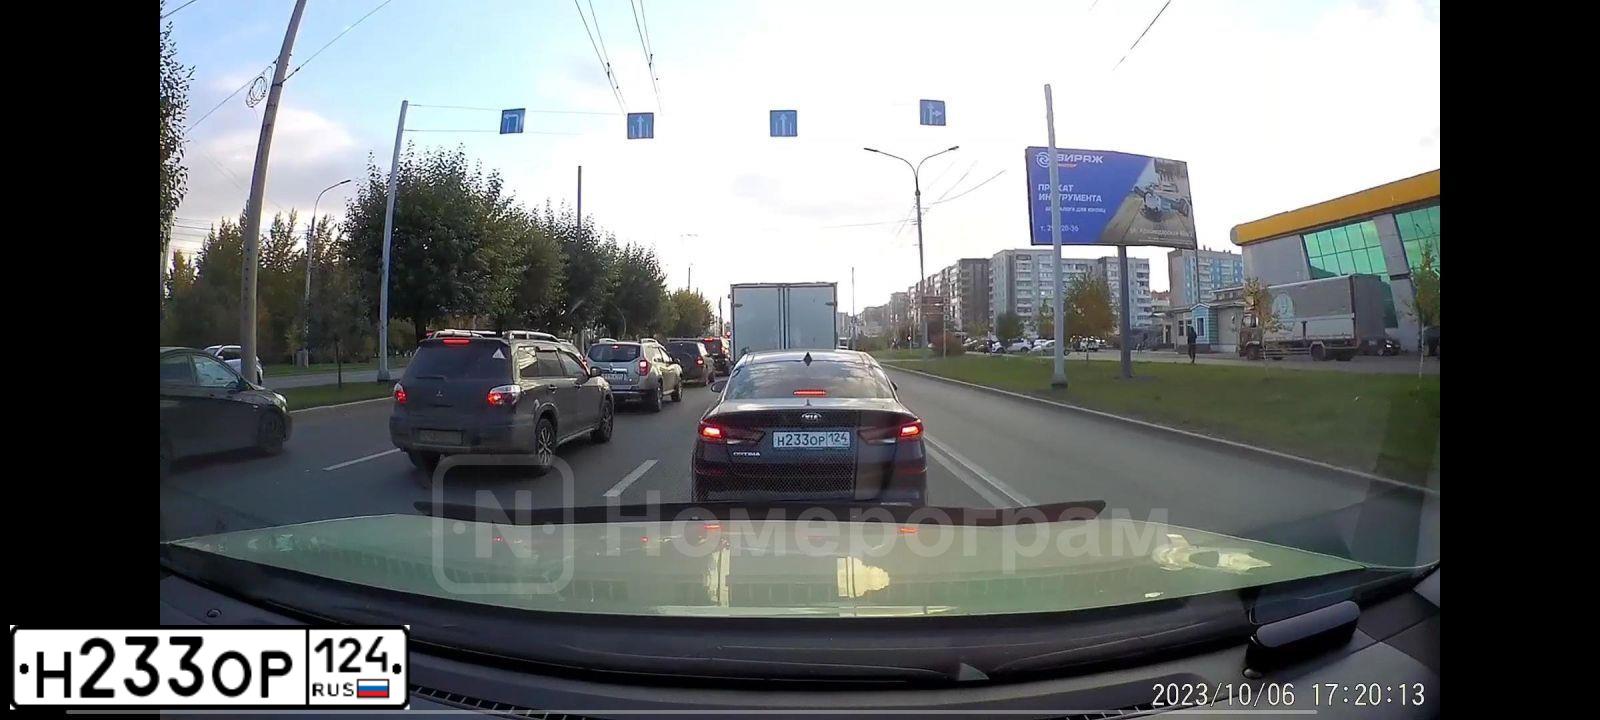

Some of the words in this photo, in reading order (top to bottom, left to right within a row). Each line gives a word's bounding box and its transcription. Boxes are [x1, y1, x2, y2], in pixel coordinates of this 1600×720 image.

[1038, 183, 1075, 193] ПРКАТ
[1038, 193, 1103, 203] ИНТРУМЕНТА
[828, 433, 848, 443] 124
